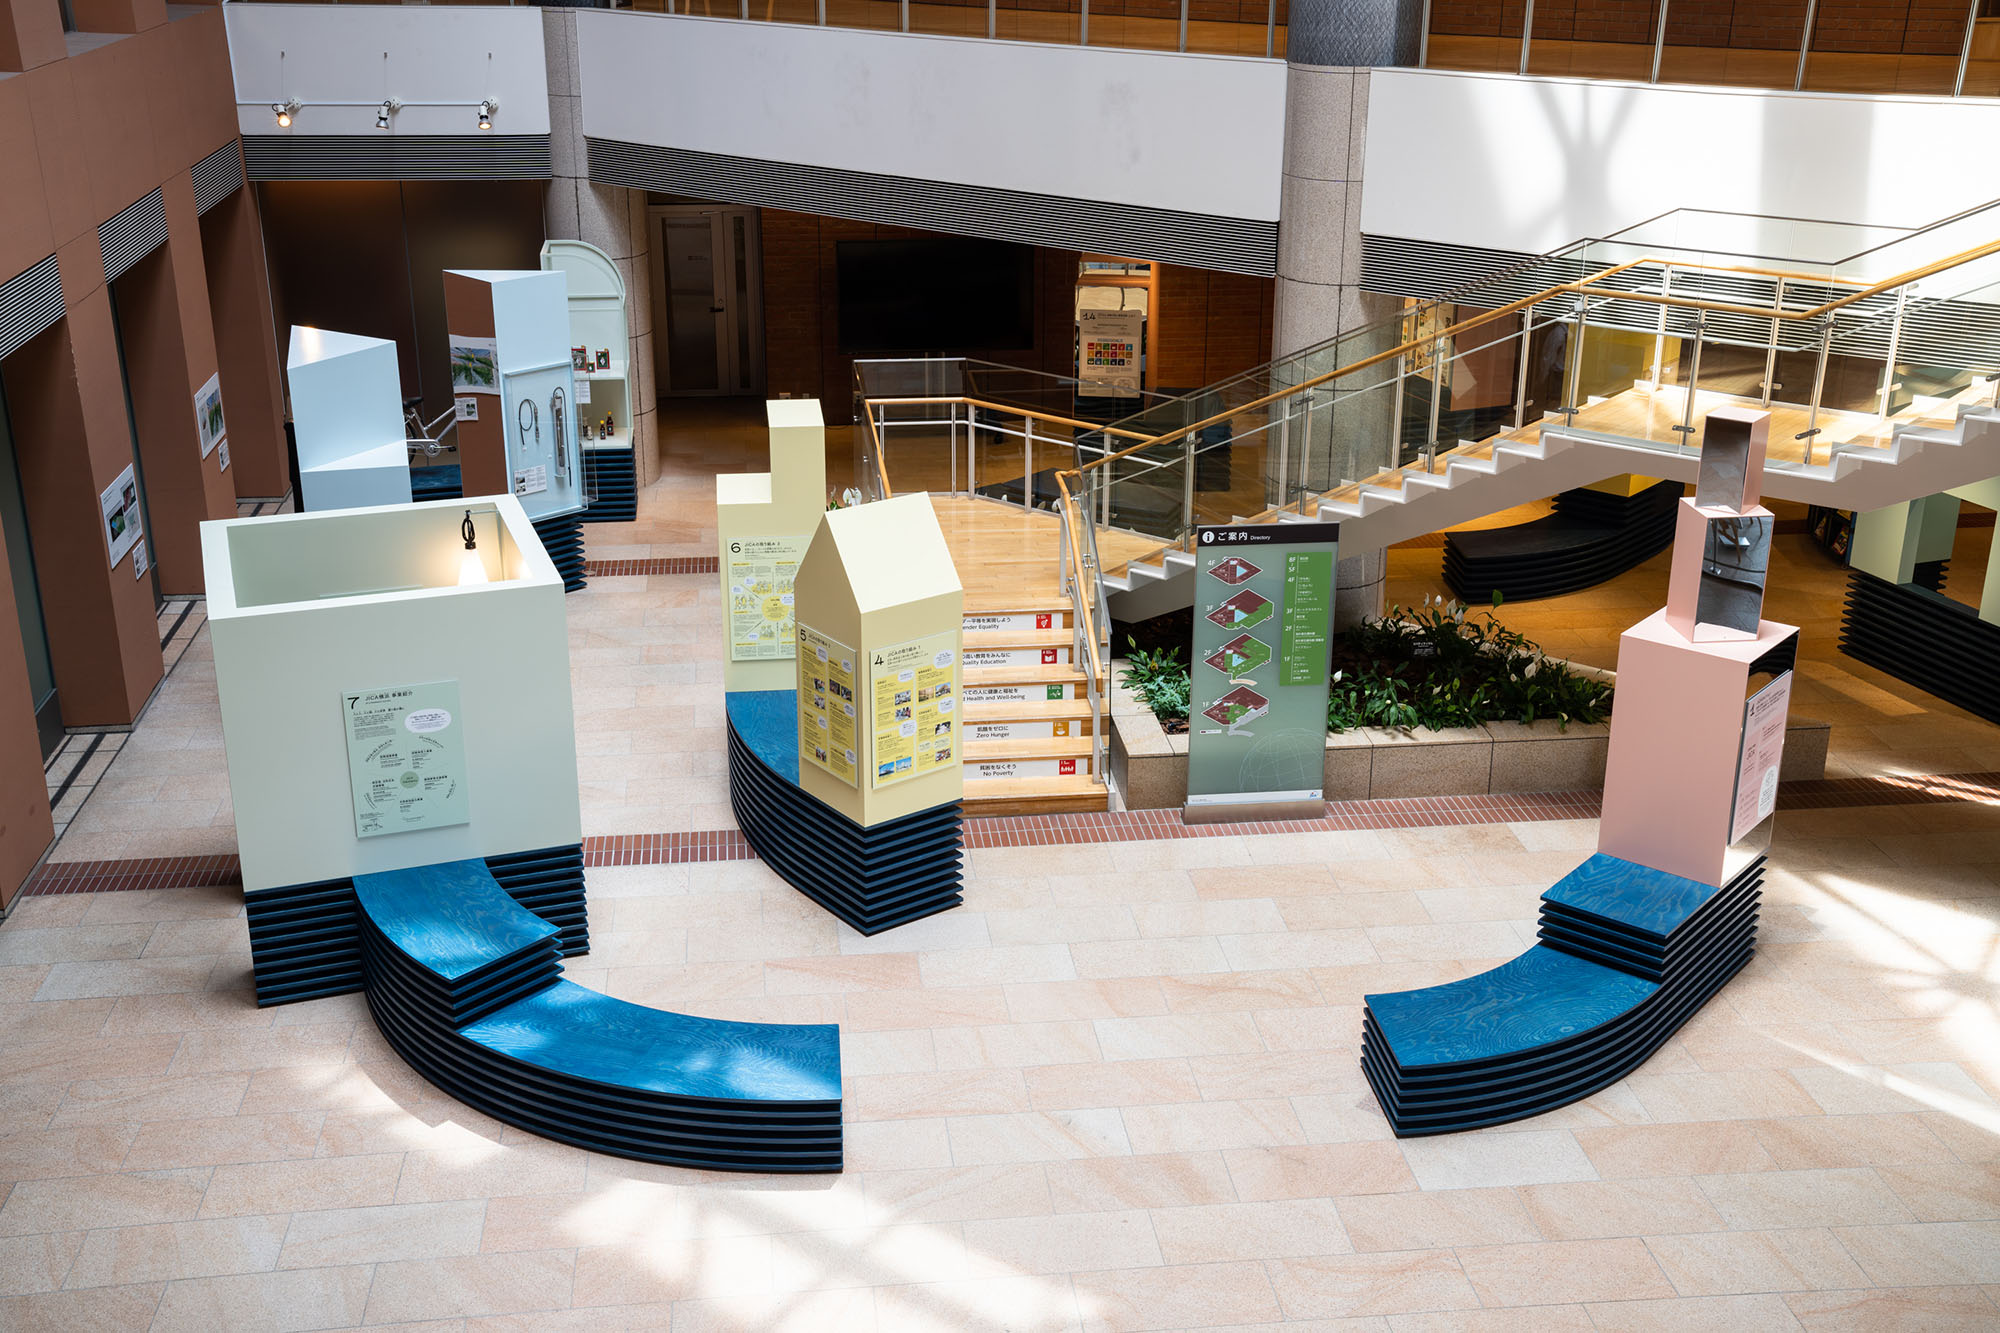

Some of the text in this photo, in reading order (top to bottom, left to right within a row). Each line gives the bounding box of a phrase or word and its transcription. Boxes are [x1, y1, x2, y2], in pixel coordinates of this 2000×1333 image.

[1083, 312, 1096, 320] 14
[1217, 531, 1248, 541] ご案内
[731, 542, 741, 553] 6
[979, 623, 999, 631] Equality
[800, 629, 806, 641] 5
[874, 655, 884, 666] 4
[347, 696, 360, 709] 7
